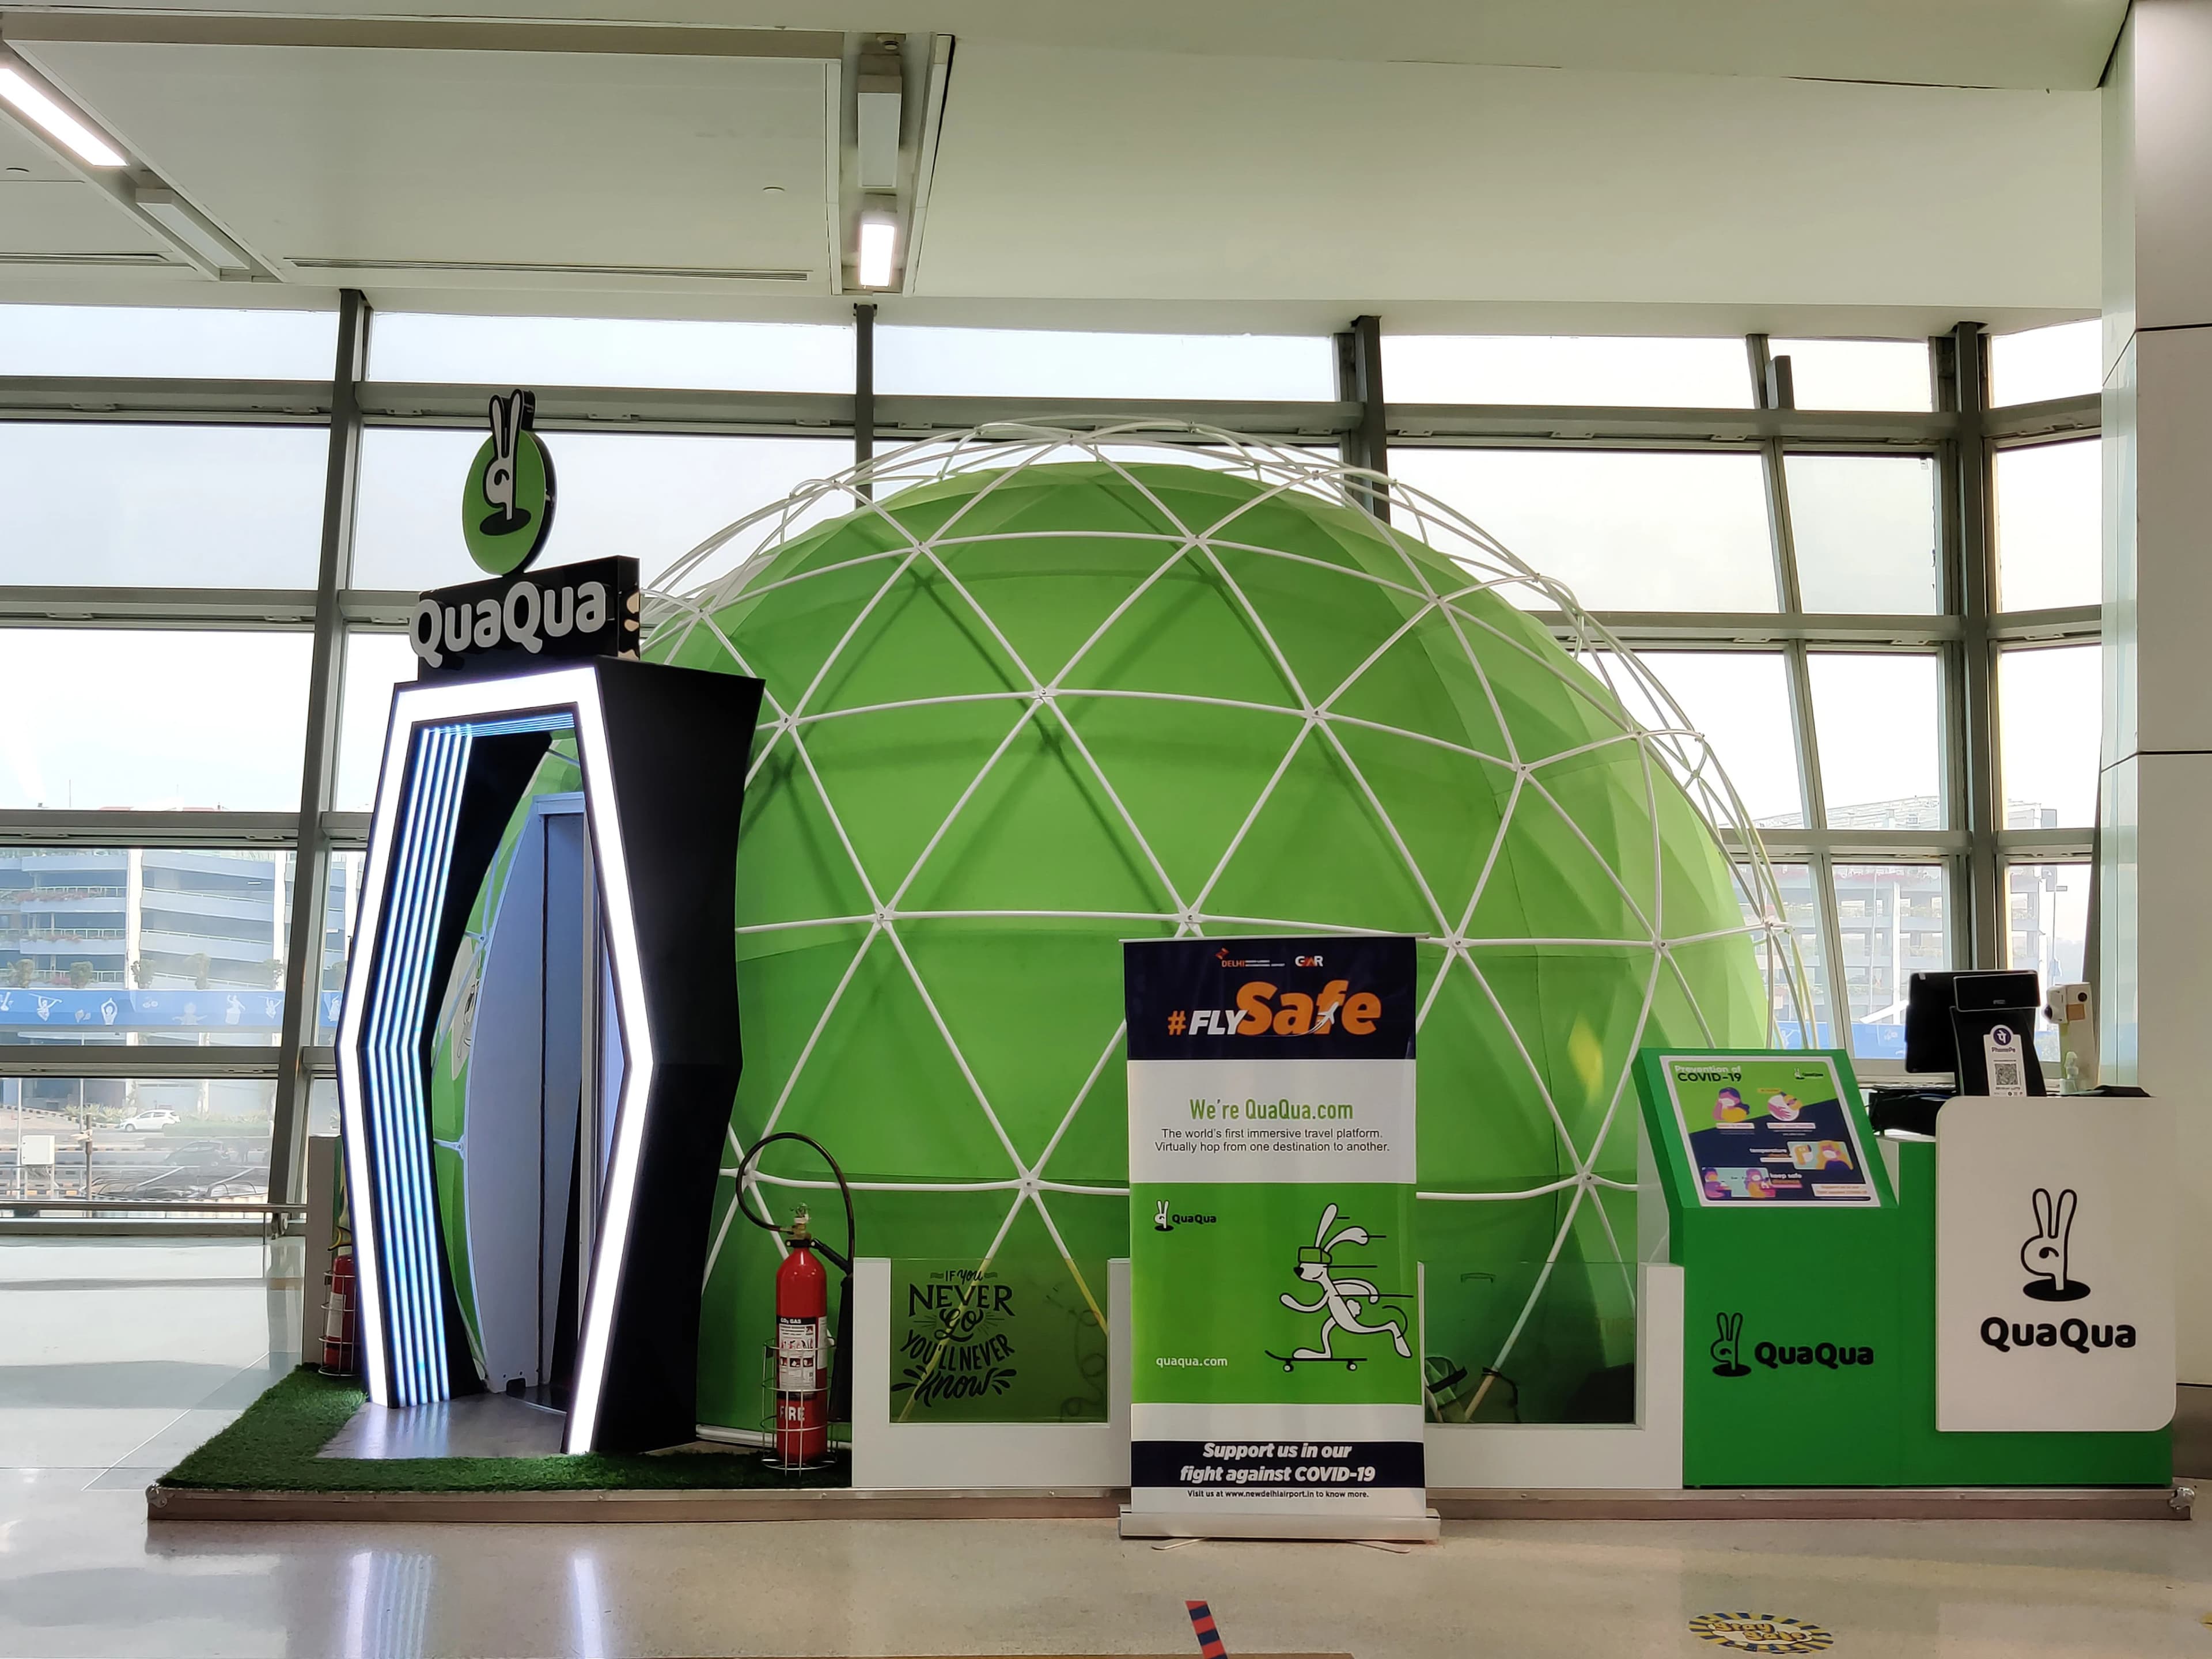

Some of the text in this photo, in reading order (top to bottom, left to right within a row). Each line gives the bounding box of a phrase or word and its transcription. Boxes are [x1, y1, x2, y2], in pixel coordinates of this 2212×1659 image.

[410, 581, 607, 669] QuaQua
[1221, 960, 1245, 968] DELHI
[1677, 1072, 1742, 1082] COVID-19
[1190, 1099, 1353, 1120] We're QuaQua.com
[1161, 1128, 1382, 1140] The world's first immersive travel platform.
[1155, 1142, 1197, 1153] Virtually
[1200, 1142, 1220, 1153] hop
[1224, 1142, 1247, 1151] from
[1273, 1142, 1330, 1152] destination
[1334, 1142, 1343, 1151] to
[1346, 1142, 1389, 1151] another.
[1172, 1214, 1217, 1225] QuaQua
[945, 1270, 956, 1281] IF
[908, 1283, 1016, 1317] NEVER
[1980, 1317, 2136, 1354] QuaQua
[959, 1334, 1015, 1372] NEVER
[1754, 1342, 1874, 1370] QuaQua
[1156, 1357, 1228, 1368] quaqua.com
[1202, 1442, 1353, 1460] Support us in our
[1180, 1465, 1376, 1484] fight against COVID-19
[1325, 1490, 1346, 1498] know
